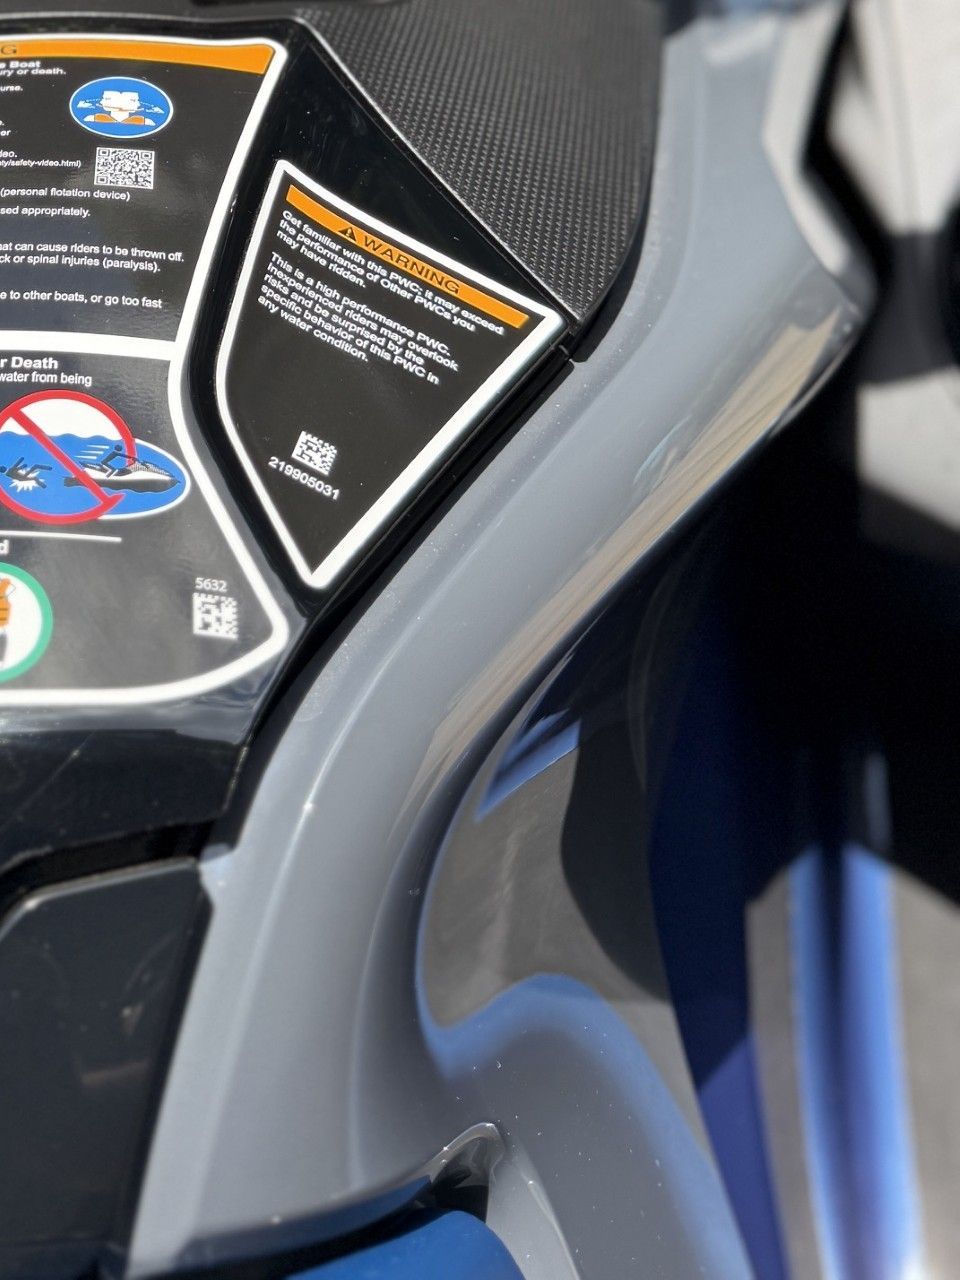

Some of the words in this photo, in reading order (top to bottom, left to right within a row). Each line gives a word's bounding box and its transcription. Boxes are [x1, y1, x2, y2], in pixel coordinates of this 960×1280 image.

[14, 243, 34, 251] can
[35, 243, 68, 252] cause
[70, 242, 100, 254] riders
[102, 244, 113, 254] to
[114, 245, 129, 256] be
[130, 246, 166, 260] thrown
[167, 251, 184, 262] off.
[276, 230, 299, 249] may
[299, 244, 327, 266] have
[328, 262, 366, 288] ridden.
[279, 219, 296, 236] the
[295, 233, 365, 275] performance
[365, 272, 380, 282] of
[379, 278, 413, 299] Other
[413, 294, 451, 320] PWCs
[451, 315, 475, 331] you
[282, 209, 302, 228] Get
[302, 223, 341, 251] familiar
[342, 248, 365, 265] with
[366, 260, 387, 277] this
[388, 271, 423, 295] PWC;
[424, 289, 433, 300] it
[433, 295, 460, 314] may
[460, 309, 504, 335] exceed
[363, 235, 460, 295] WARNING
[257, 295, 279, 313] any
[280, 309, 312, 332] water
[312, 329, 368, 362] condition.
[260, 284, 302, 315] specific
[303, 309, 353, 341] behavior
[354, 338, 369, 349] of
[369, 343, 391, 361] this
[392, 354, 426, 377] PWC
[426, 371, 439, 384] in
[263, 273, 289, 295] risks
[290, 291, 313, 308] and
[313, 303, 330, 318] be
[330, 313, 386, 346] surprised
[386, 339, 403, 355] by
[404, 349, 424, 365] the
[266, 261, 346, 313] Inexperienced
[344, 309, 378, 331] riders
[379, 326, 406, 345] may
[407, 340, 458, 371] overlook
[271, 251, 293, 273] This
[293, 268, 304, 280] is
[305, 277, 314, 286] a
[314, 280, 341, 300] high
[340, 296, 415, 338] performance
[416, 331, 450, 356] PWC.
[10, 355, 58, 369] Death
[31, 370, 58, 383] from
[60, 372, 92, 388] being
[268, 456, 340, 501] 219905031
[195, 577, 228, 591] 5632
